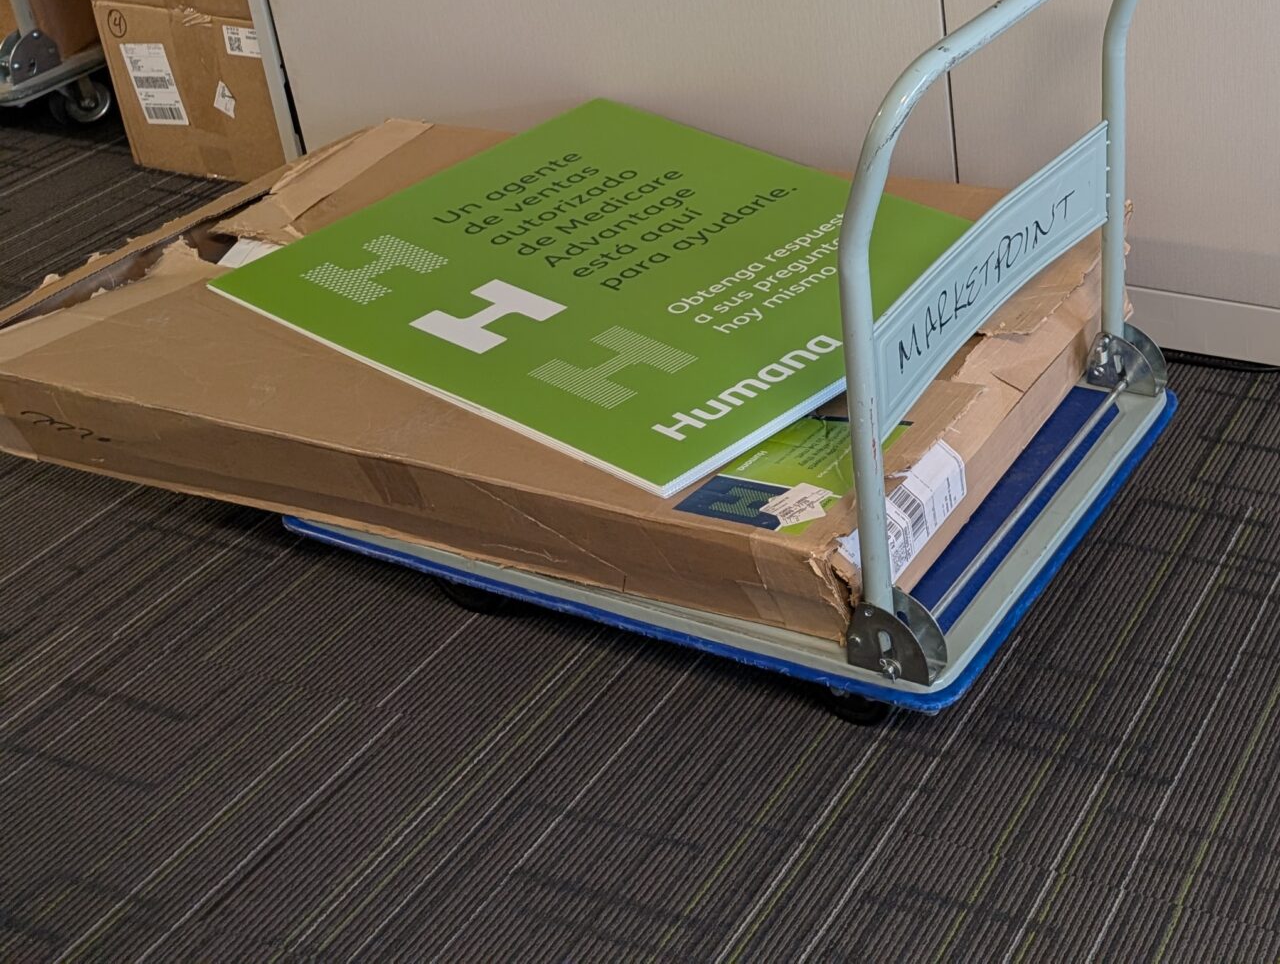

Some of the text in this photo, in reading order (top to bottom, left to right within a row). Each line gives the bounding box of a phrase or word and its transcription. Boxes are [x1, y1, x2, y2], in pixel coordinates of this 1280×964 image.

[432, 151, 582, 224] Un agente
[464, 165, 600, 235] de ventas
[490, 169, 638, 245] autorizado
[517, 169, 684, 256] de Medicare
[544, 187, 696, 268] Advantage
[572, 207, 703, 278] está aquí
[600, 187, 798, 291] para ayudarle.
[667, 213, 844, 314] Obtenga respuest
[694, 313, 714, 324] a
[713, 290, 754, 313] sus
[713, 266, 837, 334] hoy mismo
[898, 189, 1076, 375] MARKETPOINT
[651, 334, 843, 441] Humana
